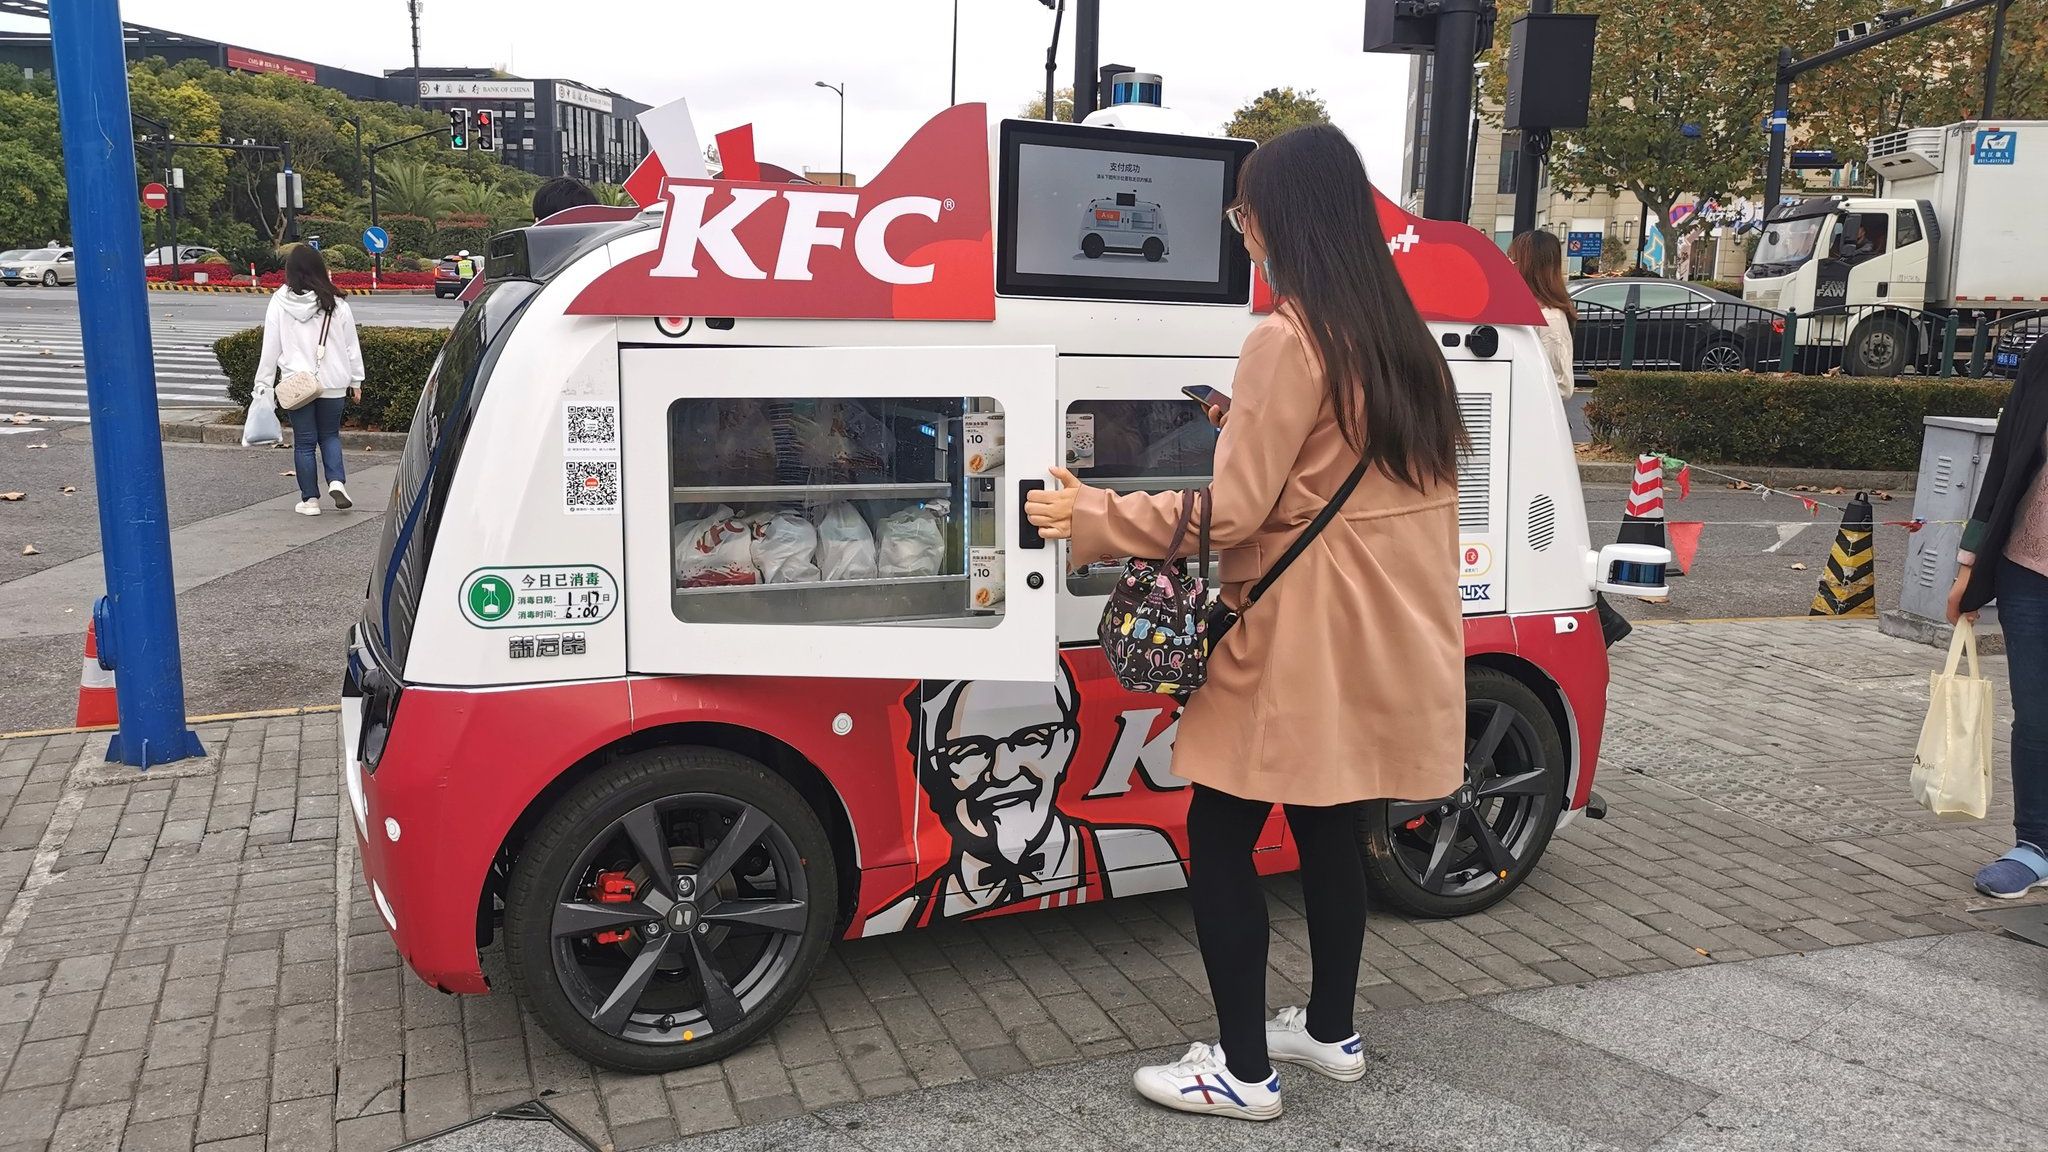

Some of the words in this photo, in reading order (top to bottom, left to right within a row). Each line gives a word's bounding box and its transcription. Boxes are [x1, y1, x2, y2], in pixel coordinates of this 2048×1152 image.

[482, 84, 500, 93] BANK
[501, 84, 508, 93] OF
[509, 84, 531, 93] CHINA
[1109, 162, 1141, 173] 支付成功
[649, 184, 942, 285] KFC
[1816, 288, 1845, 297] FAW
[521, 572, 600, 588] 今日已消毒
